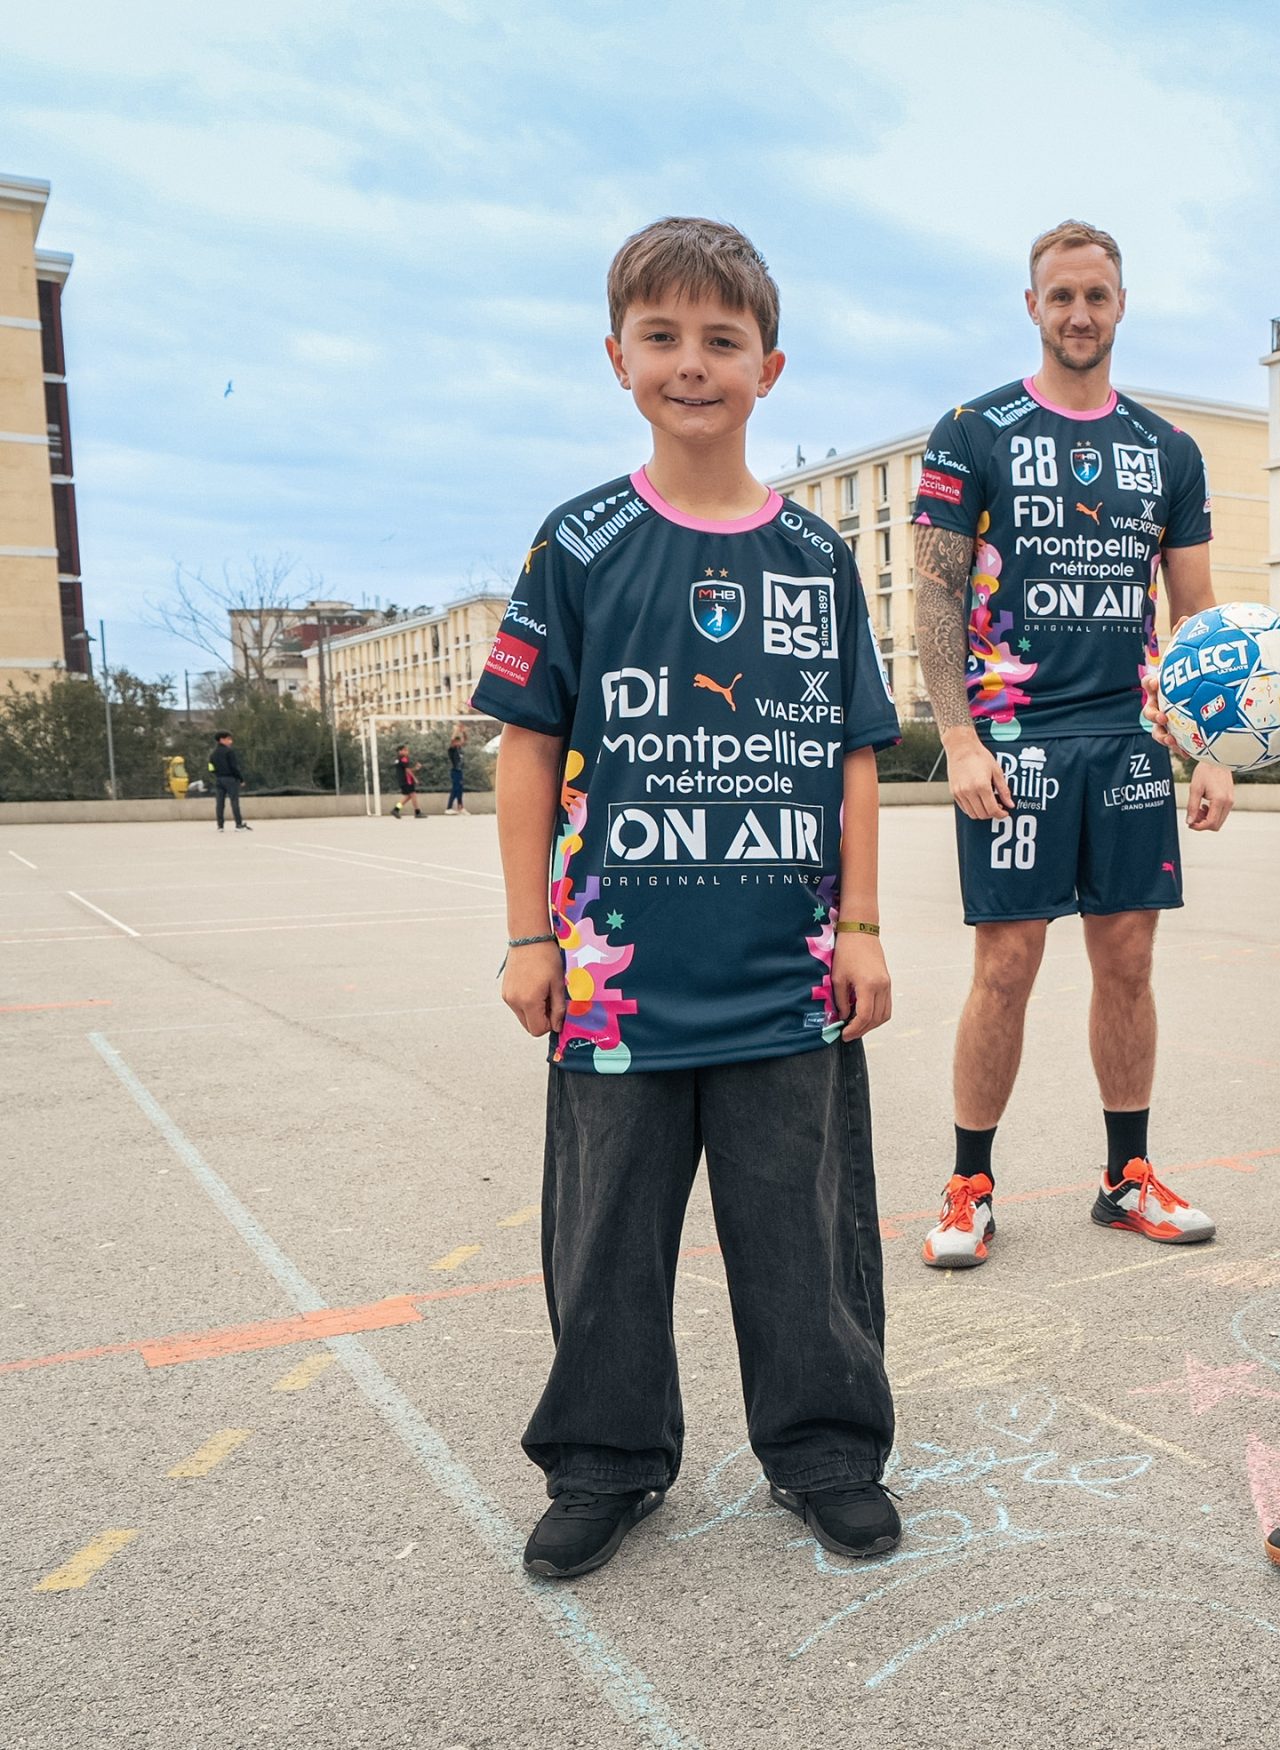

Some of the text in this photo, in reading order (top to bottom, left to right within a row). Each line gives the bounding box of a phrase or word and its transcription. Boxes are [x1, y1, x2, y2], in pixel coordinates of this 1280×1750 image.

[938, 450, 971, 474] France
[1010, 435, 1058, 487] 28
[1120, 450, 1147, 472] M
[1116, 470, 1153, 494] BS
[555, 496, 650, 567] PARTOUCHE
[698, 589, 736, 600] MHB
[774, 585, 812, 624] M
[1027, 583, 1085, 617] ON
[819, 589, 829, 648] since 1897
[1024, 625, 1092, 634] ORIGINAL
[763, 619, 821, 660] BS
[1162, 639, 1249, 695] SELECT
[755, 698, 844, 724] VIAEXPE
[609, 808, 820, 862] ON AIR
[990, 814, 1038, 870] 28
[602, 875, 720, 887] ORIGINAL
